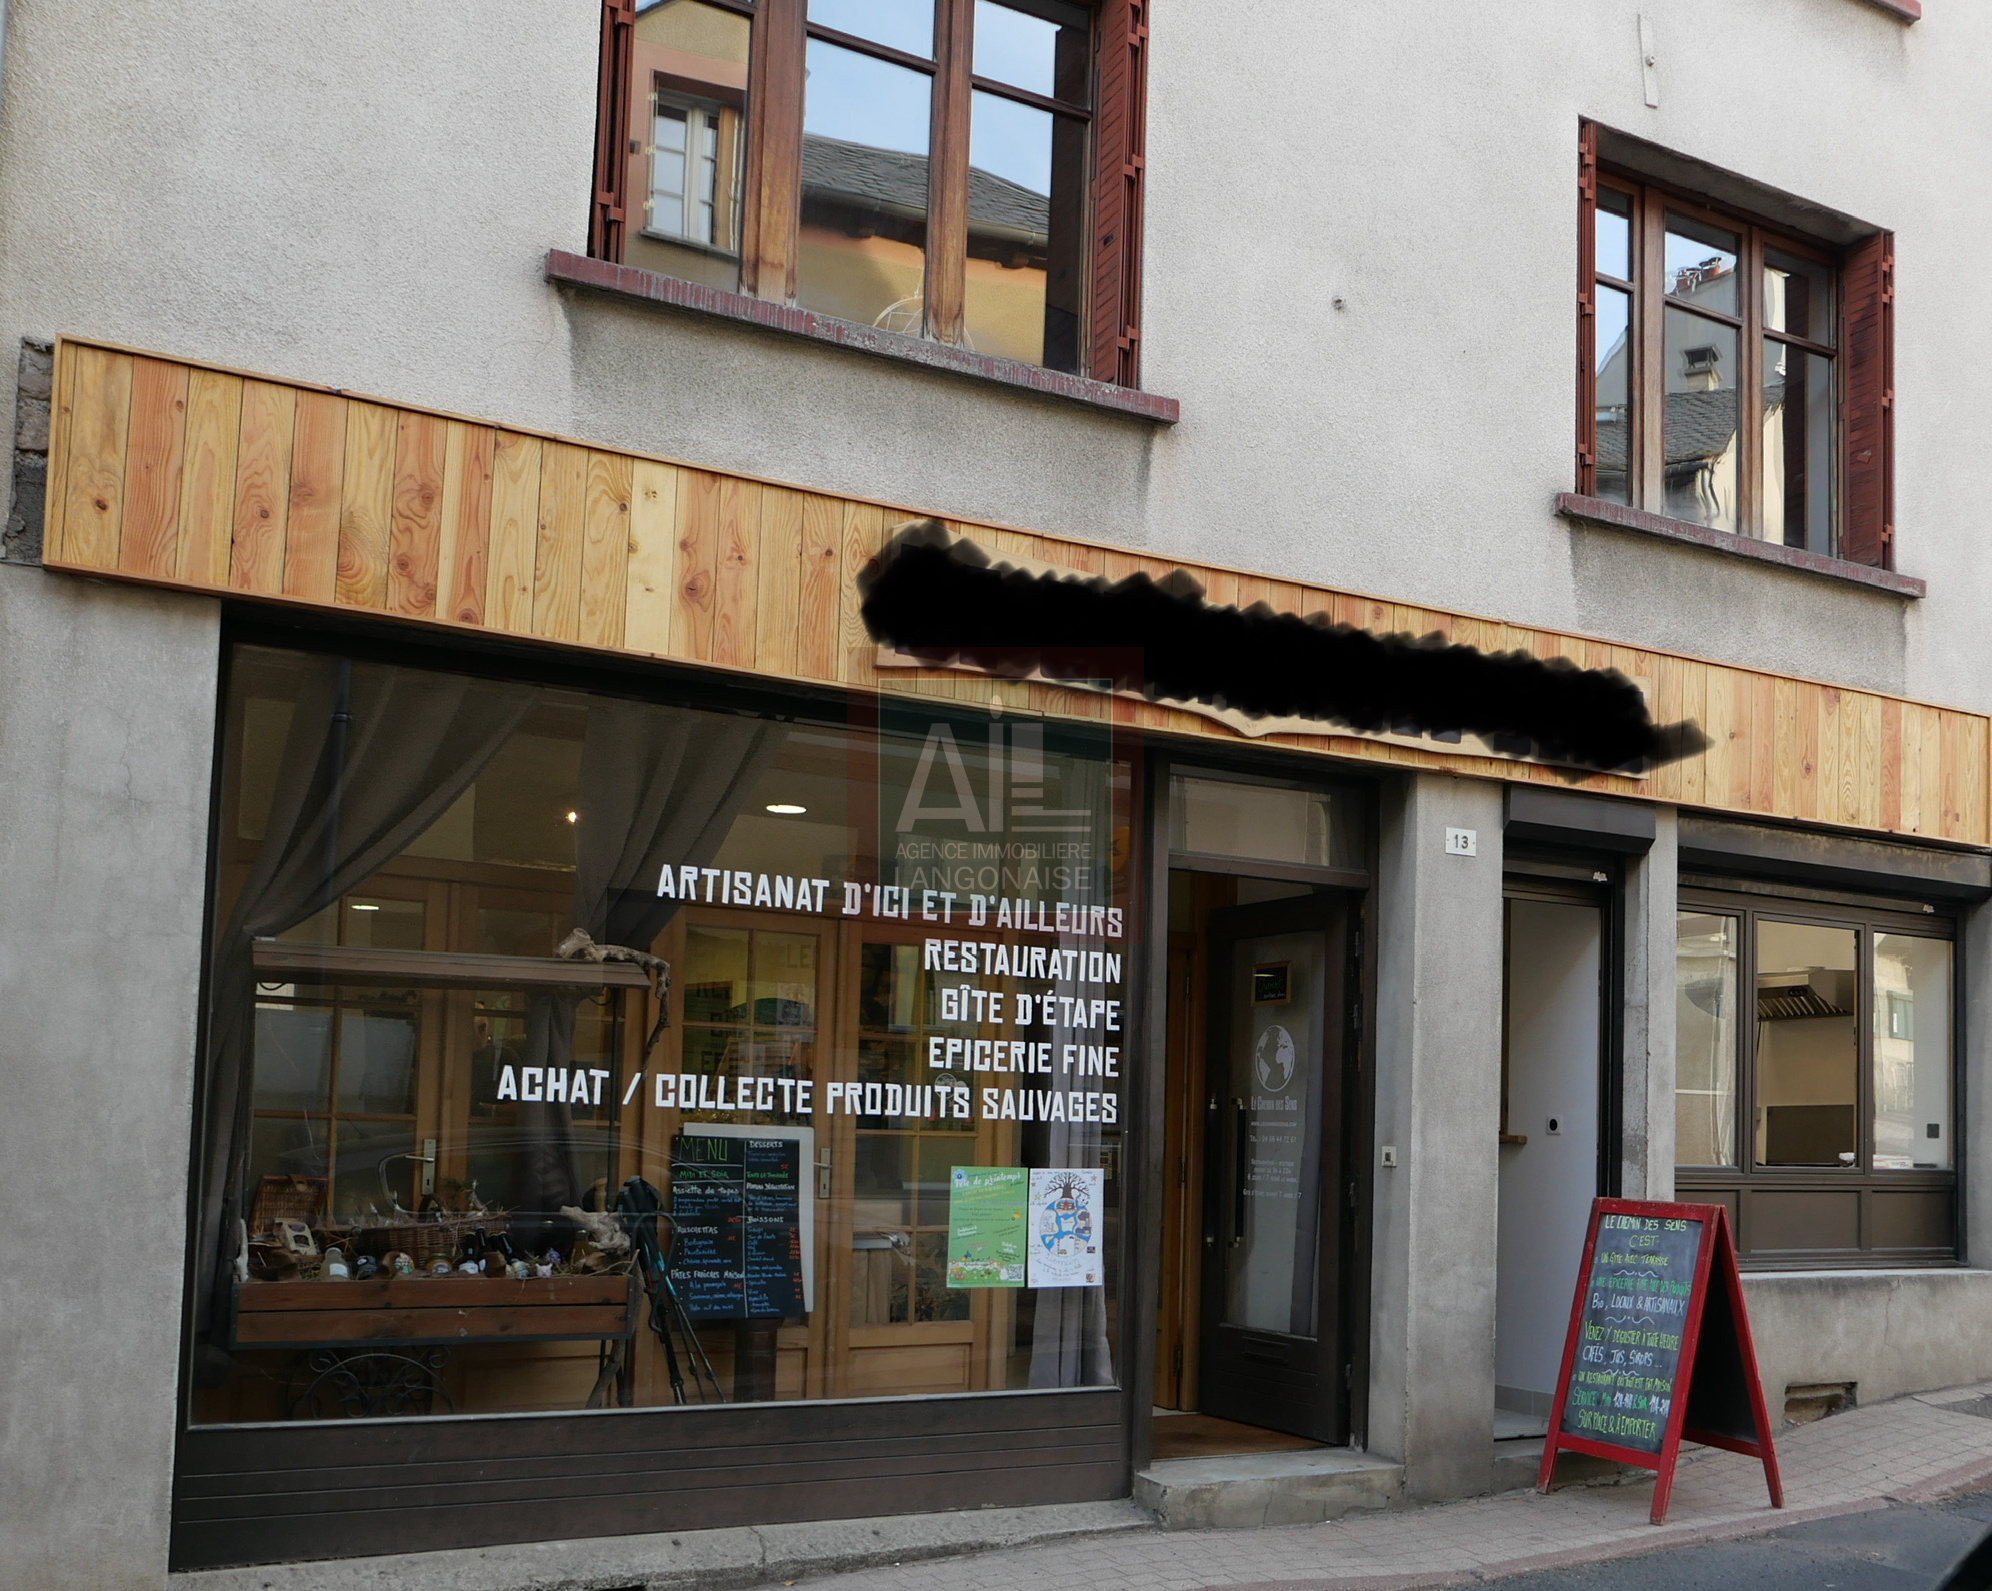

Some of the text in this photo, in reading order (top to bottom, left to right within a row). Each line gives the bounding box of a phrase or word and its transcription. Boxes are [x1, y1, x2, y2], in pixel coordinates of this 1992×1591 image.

[1454, 833, 1469, 850] 13
[657, 864, 1123, 938] ARTISANAT D'ICI ET D'AILLEURS
[924, 938, 1121, 984] RESTAURATION
[941, 984, 1121, 1031] GÎTE D'ÉTAPE
[929, 1036, 1052, 1074] EPICERIE
[1062, 1043, 1119, 1077] FINE
[497, 1064, 1117, 1123] ACHAT / COLLECTE PRODUITS SAUVAGES
[679, 1137, 728, 1162] MENU
[749, 1140, 784, 1149] DESSERTS
[747, 1214, 785, 1225] BOISSONS
[1605, 1214, 1617, 1230] LE
[1643, 1218, 1659, 1232] DES
[1584, 1319, 1605, 1342] VENEZ
